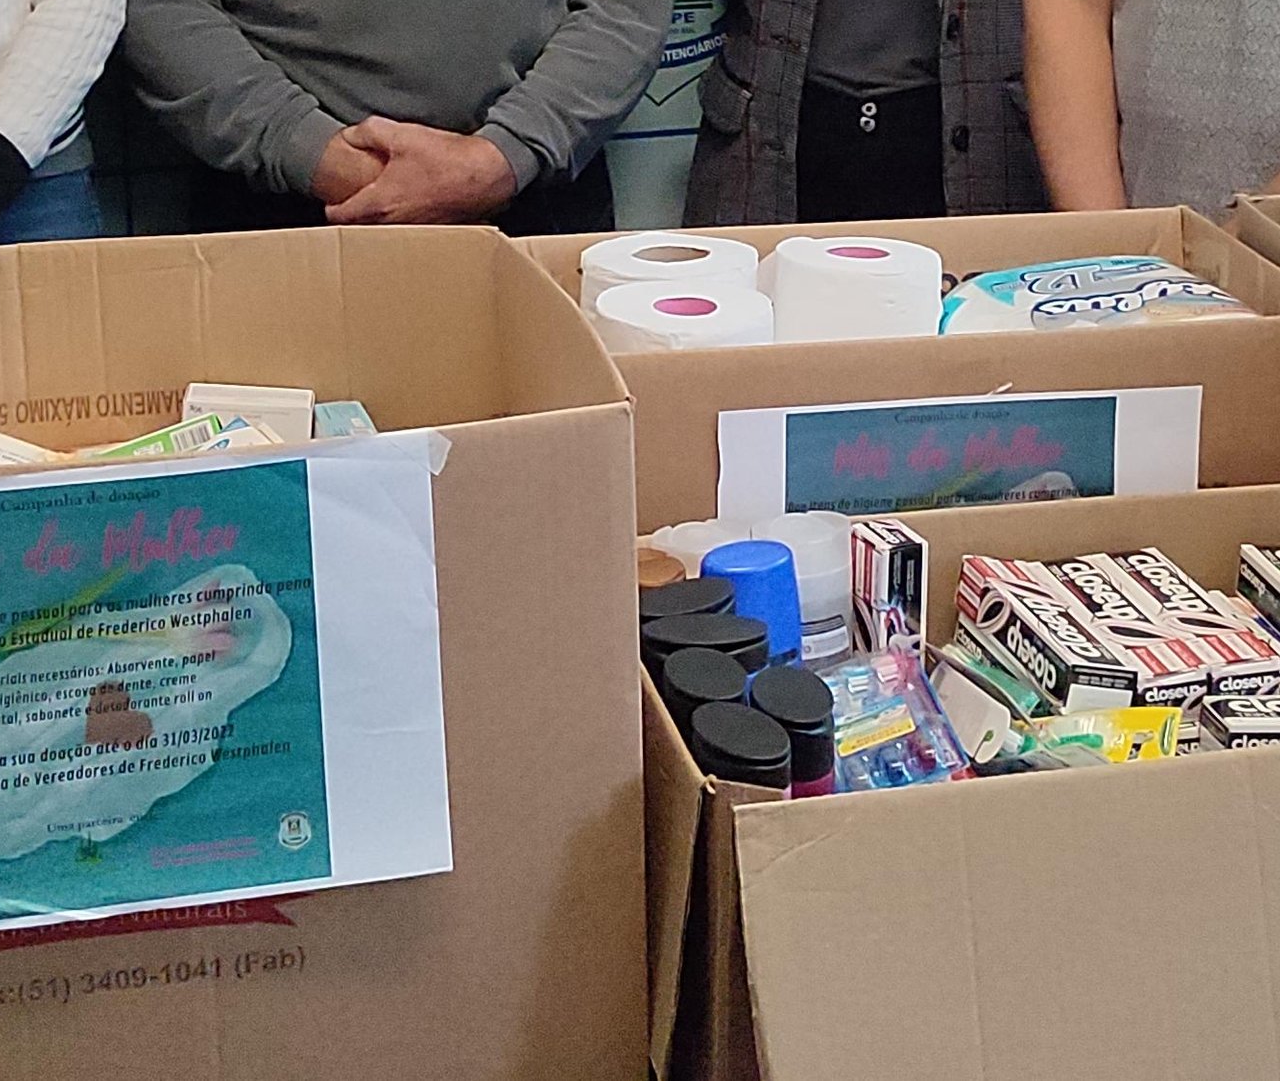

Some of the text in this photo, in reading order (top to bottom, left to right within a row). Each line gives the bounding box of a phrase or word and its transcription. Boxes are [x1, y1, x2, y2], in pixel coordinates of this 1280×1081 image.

[0, 403, 9, 419] 5
[16, 395, 91, 428] MÁXIMO
[96, 389, 184, 415] HAMENTO
[1061, 562, 1138, 620] closeup
[1128, 554, 1208, 612] closeup
[11, 605, 65, 626] pessoal
[69, 601, 101, 620] para
[126, 590, 192, 610] mulheres
[196, 580, 272, 604] cumprindo
[276, 577, 311, 593] pena
[11, 626, 72, 645] Estadual
[77, 625, 93, 639] de
[98, 616, 166, 637] Frederico
[170, 606, 252, 629] Westphalen
[30, 664, 105, 683] necessários:
[107, 656, 178, 676] Absorvente,
[182, 650, 216, 668] papel
[55, 685, 97, 701] escova
[100, 681, 114, 695] de
[117, 677, 156, 693] dente,
[159, 673, 197, 687] creme
[1145, 685, 1206, 703] closeup
[1220, 676, 1280, 692] closeup
[25, 706, 81, 723] sabonete
[95, 695, 171, 714] desodorante
[173, 691, 195, 705] roll
[198, 689, 212, 701] on
[11, 753, 35, 766] sua
[40, 742, 91, 763] doação
[96, 740, 119, 755] até
[123, 741, 132, 751] o
[135, 735, 158, 751] dia
[13, 774, 30, 788] de
[34, 763, 114, 786] Vereadores
[119, 760, 135, 774] de
[139, 752, 206, 772] Frederico
[211, 741, 291, 763] Westphalen
[81, 954, 221, 996] 3409-1041
[233, 944, 307, 980] (Fab)
